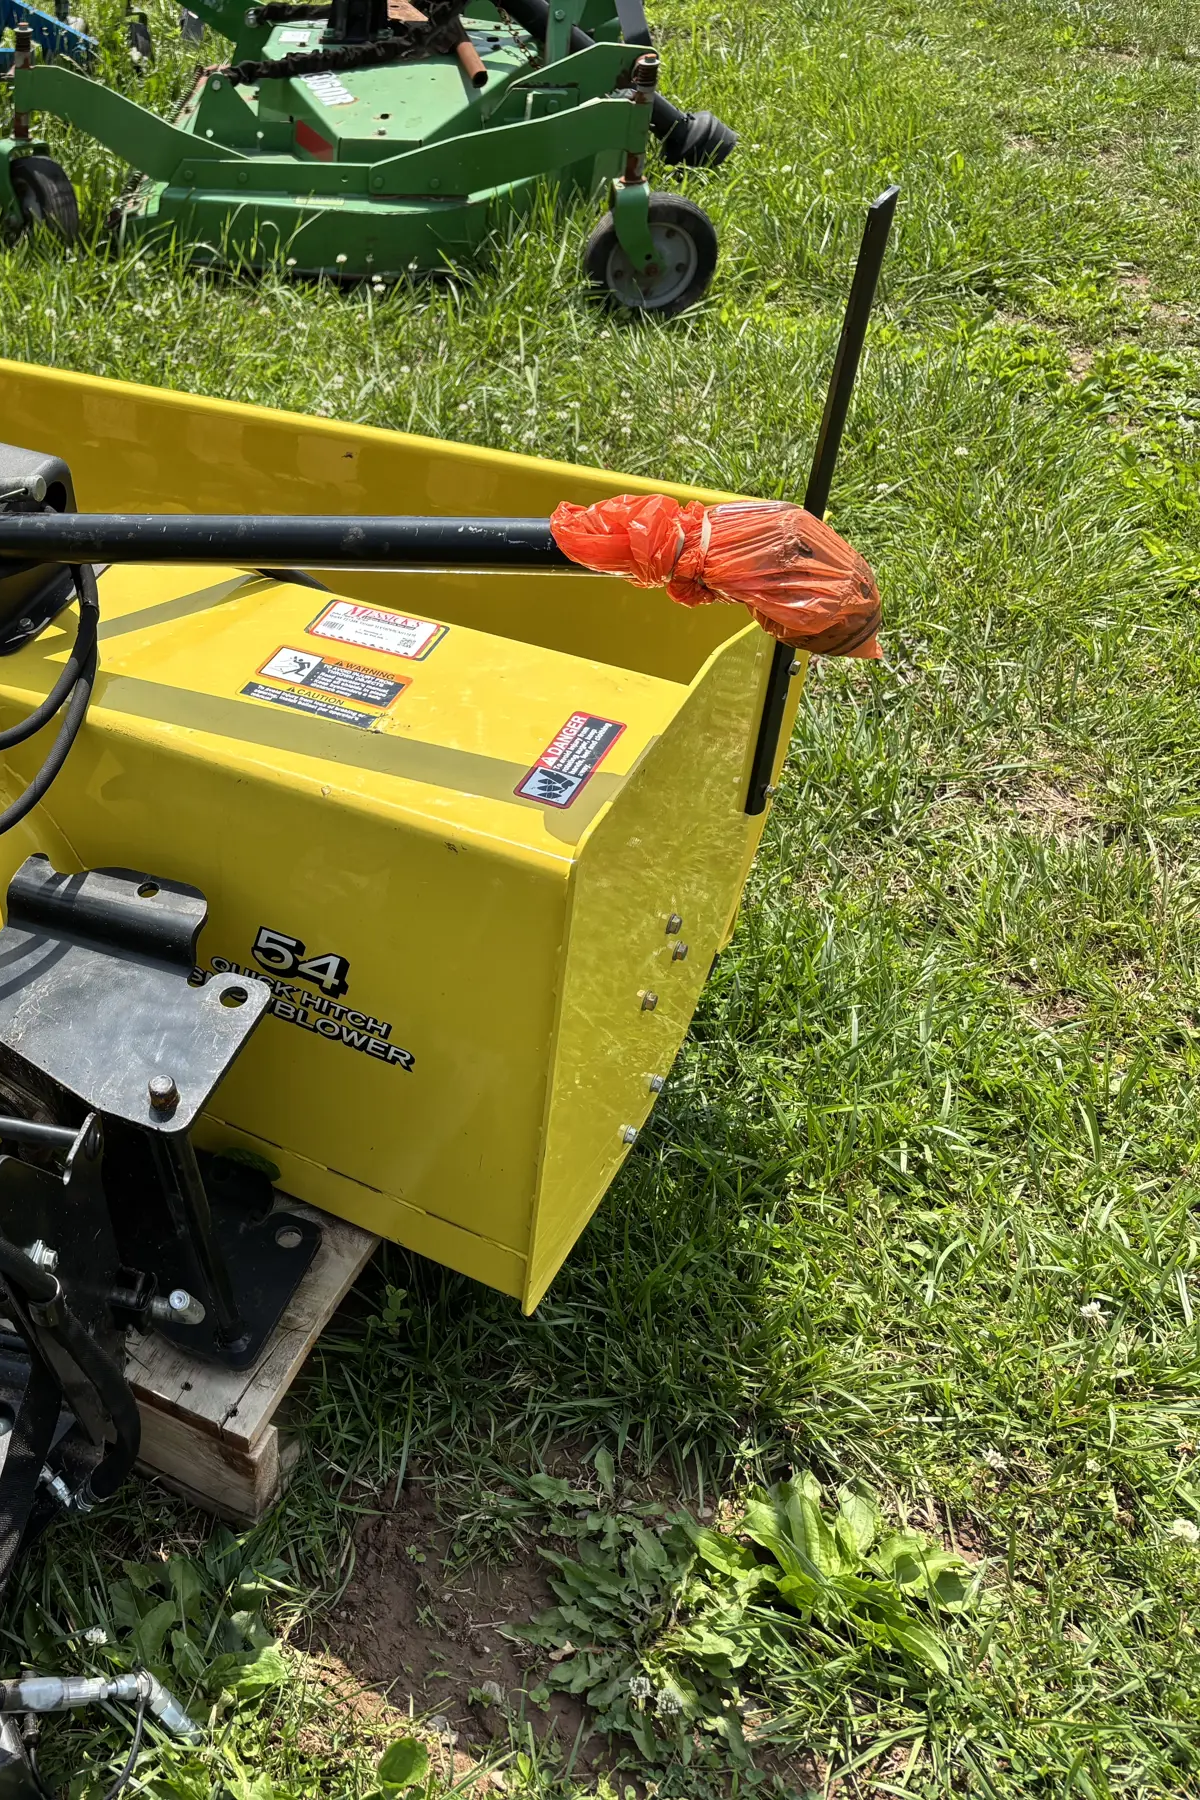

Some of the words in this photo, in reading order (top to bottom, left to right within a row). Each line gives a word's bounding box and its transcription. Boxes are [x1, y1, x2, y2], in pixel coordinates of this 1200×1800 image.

[346, 662, 396, 680] WARNING
[297, 687, 345, 706] CAUTION
[547, 715, 588, 756] DANGER
[559, 750, 573, 764] avoid
[567, 737, 583, 751] injury
[577, 726, 590, 738] from
[562, 754, 580, 773] rotating
[584, 728, 598, 740] keep
[587, 740, 599, 750] and
[594, 722, 613, 741] clothing
[251, 925, 350, 999] 54
[300, 986, 392, 1039] HITCH
